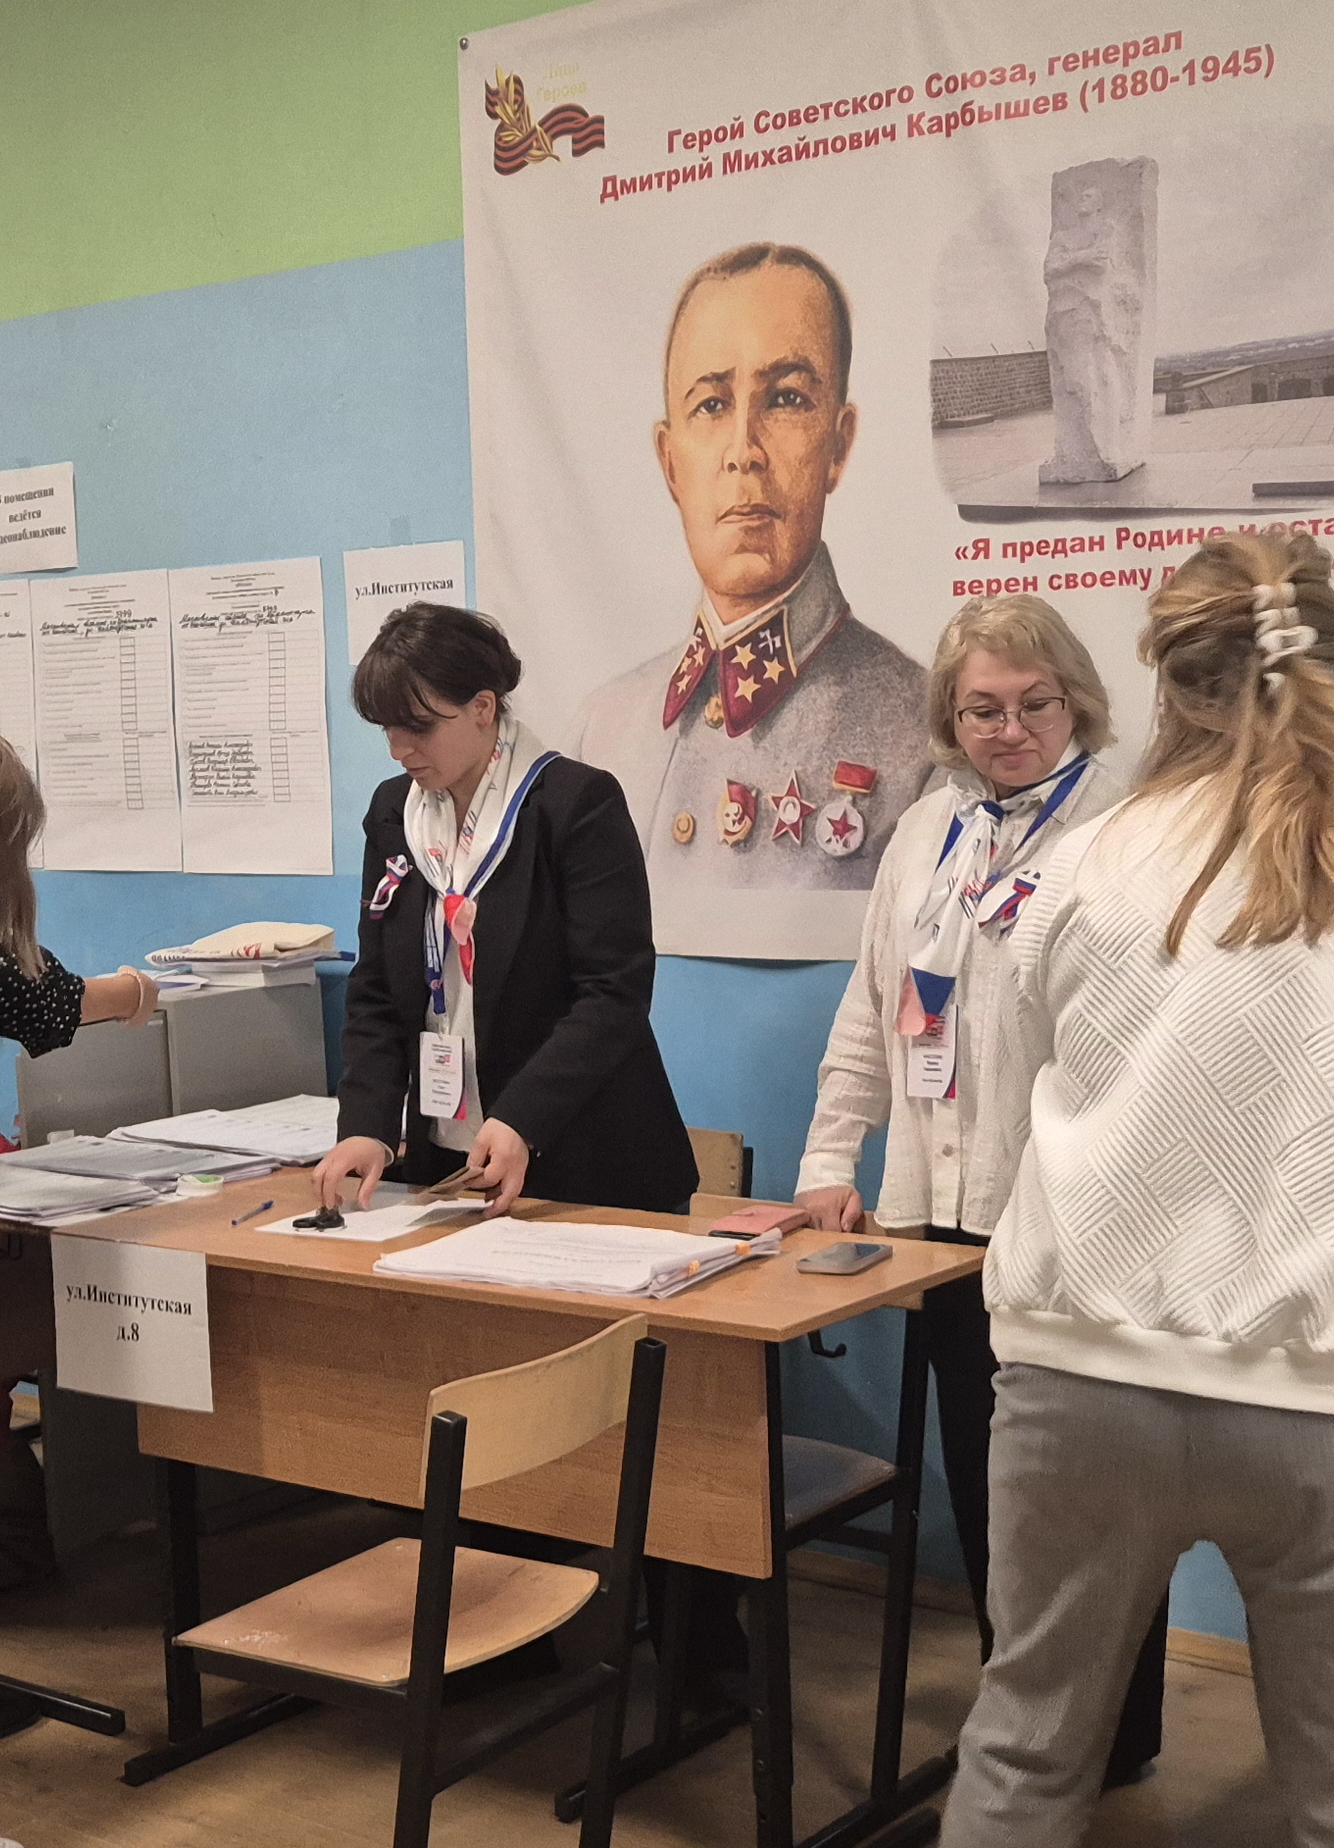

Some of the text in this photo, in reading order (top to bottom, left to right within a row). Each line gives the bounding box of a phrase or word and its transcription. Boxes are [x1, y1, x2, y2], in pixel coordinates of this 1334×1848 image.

[667, 29, 1183, 154] Герой Советского Союза, генерал
[599, 42, 1276, 204] Дмитрий Михайлович Карбышев (1880-1945)
[954, 537, 992, 562] «Я
[1001, 532, 1106, 564] предан
[354, 578, 454, 601] ул.Институтская
[952, 565, 1039, 598] верен
[1047, 565, 1153, 593] своему
[66, 1283, 193, 1316] ул.Институтская
[115, 1321, 141, 1343] д.8
